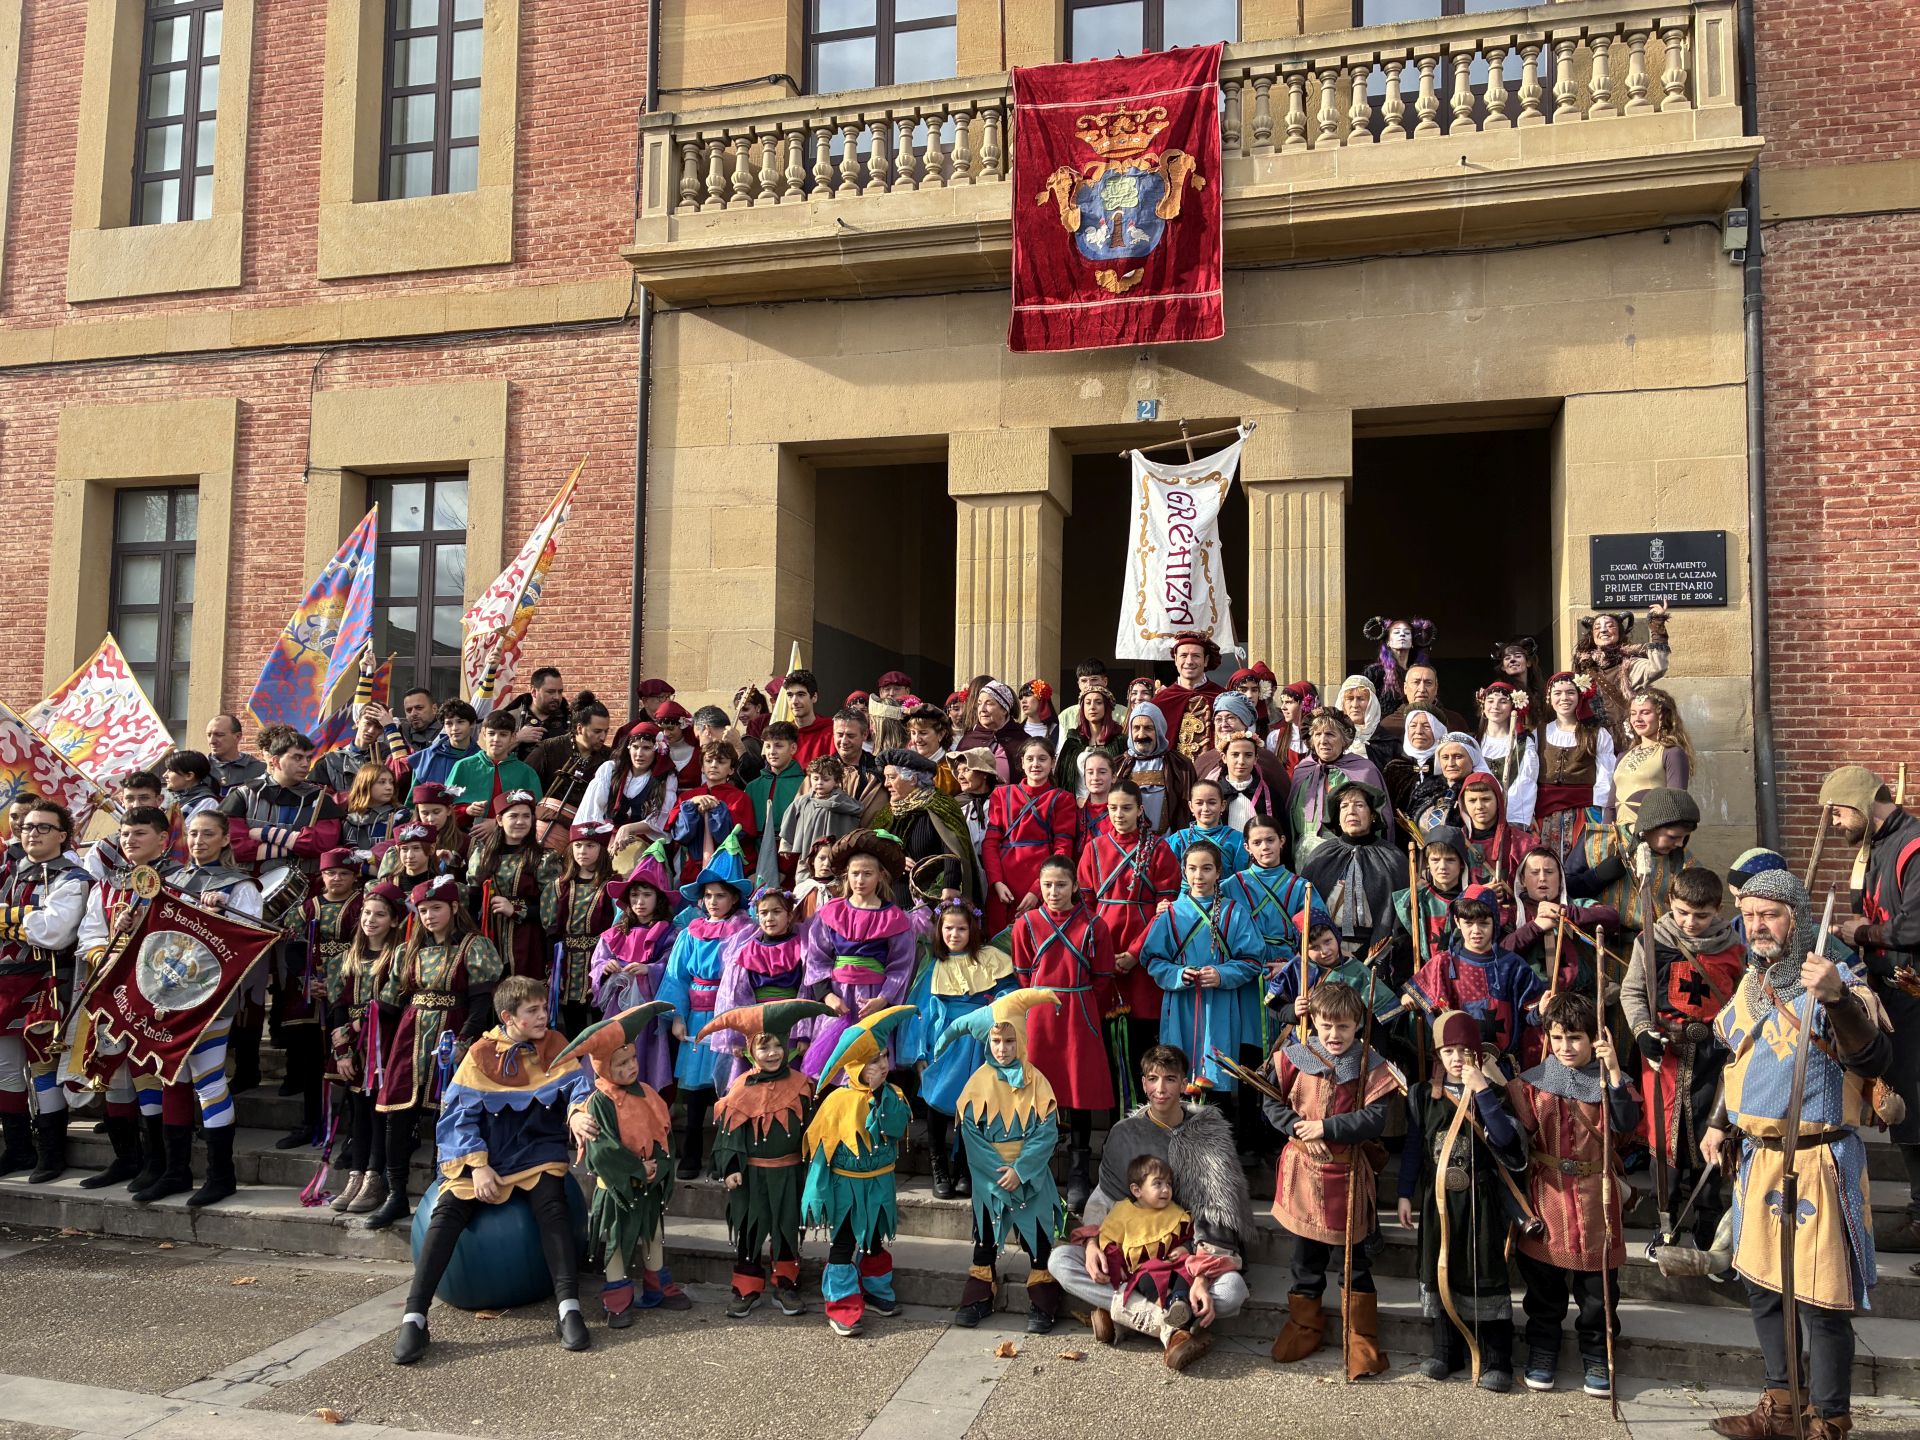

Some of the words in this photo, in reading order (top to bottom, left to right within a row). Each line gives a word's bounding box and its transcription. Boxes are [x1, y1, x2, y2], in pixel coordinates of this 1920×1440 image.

[1141, 401, 1152, 418] 2
[1164, 490, 1200, 626] GRÉHIZA
[1642, 561, 1707, 571] AYUNTAMIENTO
[1618, 572, 1654, 581] DOMINGO
[1655, 572, 1665, 580] DE
[1666, 572, 1677, 580] LA
[1679, 571, 1718, 579] CALZADA
[1604, 583, 1643, 593] PRIMER
[1649, 581, 1714, 592] CENTENARIO
[1629, 593, 1678, 602] SEPTIEMBRE
[159, 901, 239, 963] Sbandieratori
[124, 1005, 137, 1023] di
[133, 1015, 173, 1043] Amelia
